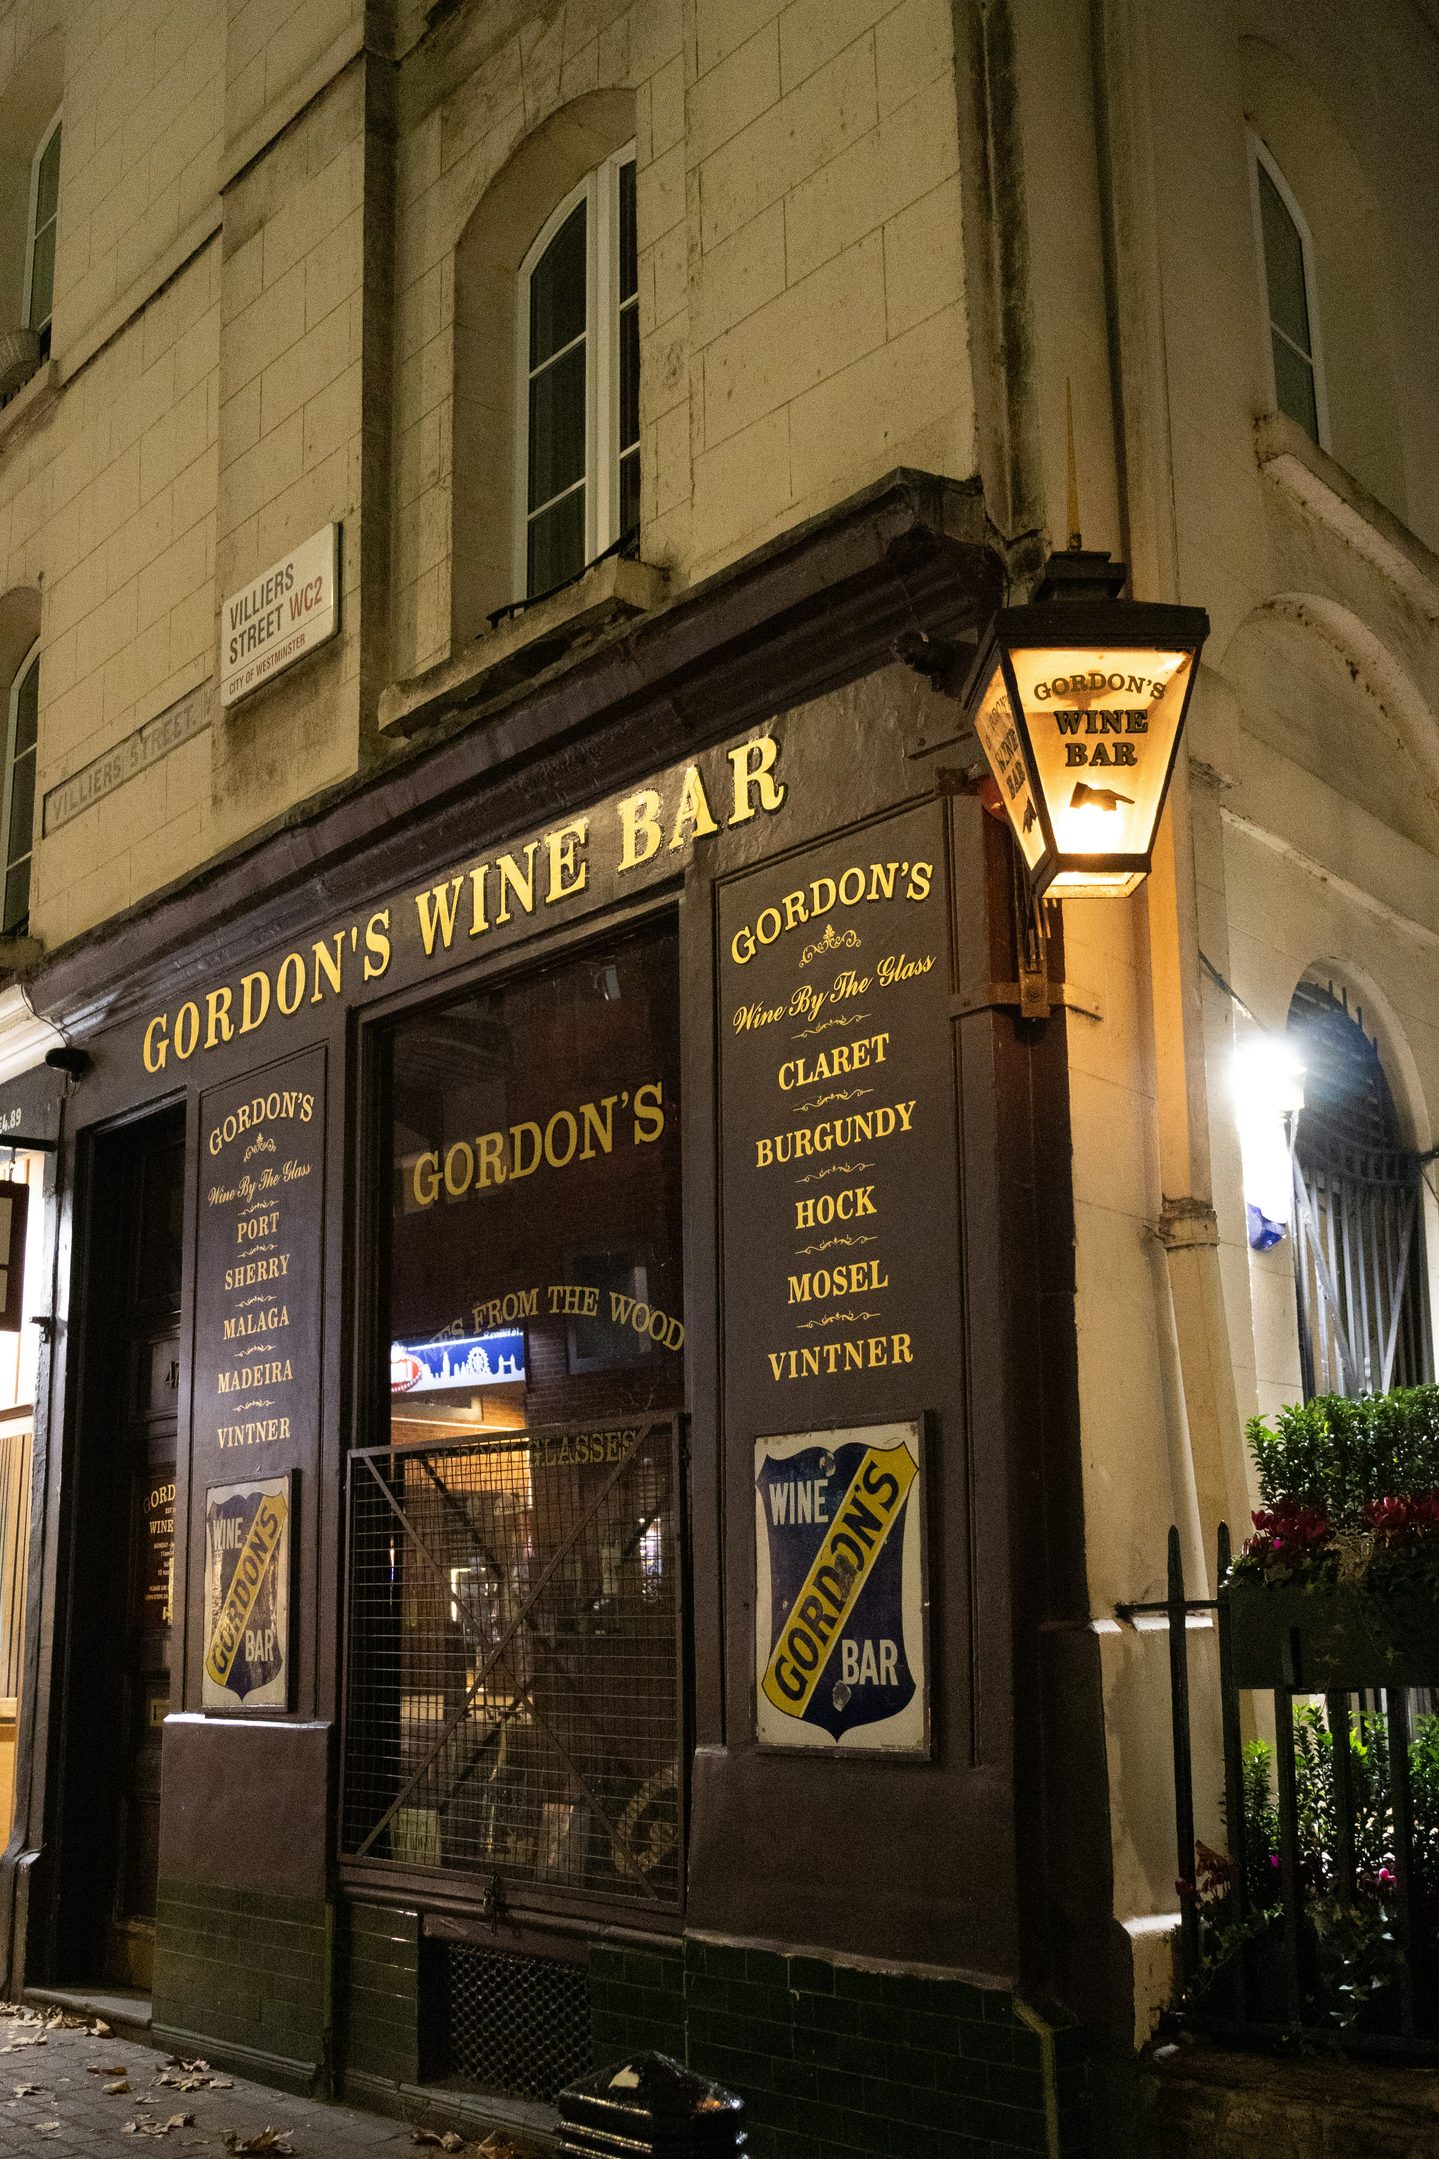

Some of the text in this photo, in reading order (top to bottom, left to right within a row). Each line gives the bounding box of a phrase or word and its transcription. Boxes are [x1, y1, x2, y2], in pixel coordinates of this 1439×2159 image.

[230, 562, 294, 631] VILLIERS
[229, 576, 323, 665] STREET WC2
[229, 633, 306, 695] CITY OF WESTMINSTER
[1034, 672, 1167, 701] GORDON'S
[1054, 709, 1149, 735] WINE
[1065, 742, 1138, 767] BAR
[53, 755, 122, 821] VILLIERS
[143, 735, 785, 1073] GORDON'S WINE BAR
[731, 861, 933, 965] GORDON'S
[733, 954, 937, 1035] Wine By The Glass
[778, 1033, 890, 1091] CLARET
[209, 1092, 314, 1156] GORDON'S
[413, 1081, 666, 1206] GORDON'S
[755, 1100, 916, 1168] BURGUNDY
[207, 1160, 313, 1207] Wine By The Glass
[795, 1185, 877, 1229] HOCK
[237, 1211, 280, 1243] PORT
[224, 1254, 291, 1291] SHERRY
[787, 1260, 888, 1304] MOSEL
[223, 1305, 290, 1340] MALAGA
[472, 1288, 540, 1335] FROM
[547, 1285, 600, 1317] THE
[609, 1292, 685, 1351] WOOD
[217, 1359, 294, 1394] MADEIRA
[768, 1333, 914, 1381] VINTNER
[217, 1417, 291, 1449] VINTNER
[769, 1479, 829, 1526] WINE
[150, 1519, 174, 1534] WINE
[212, 1517, 243, 1550] WINE
[210, 1504, 280, 1676] GORDON'S
[774, 1460, 901, 1703] GORDON'S
[245, 1630, 275, 1662] BAR
[842, 1639, 898, 1686] BAR
